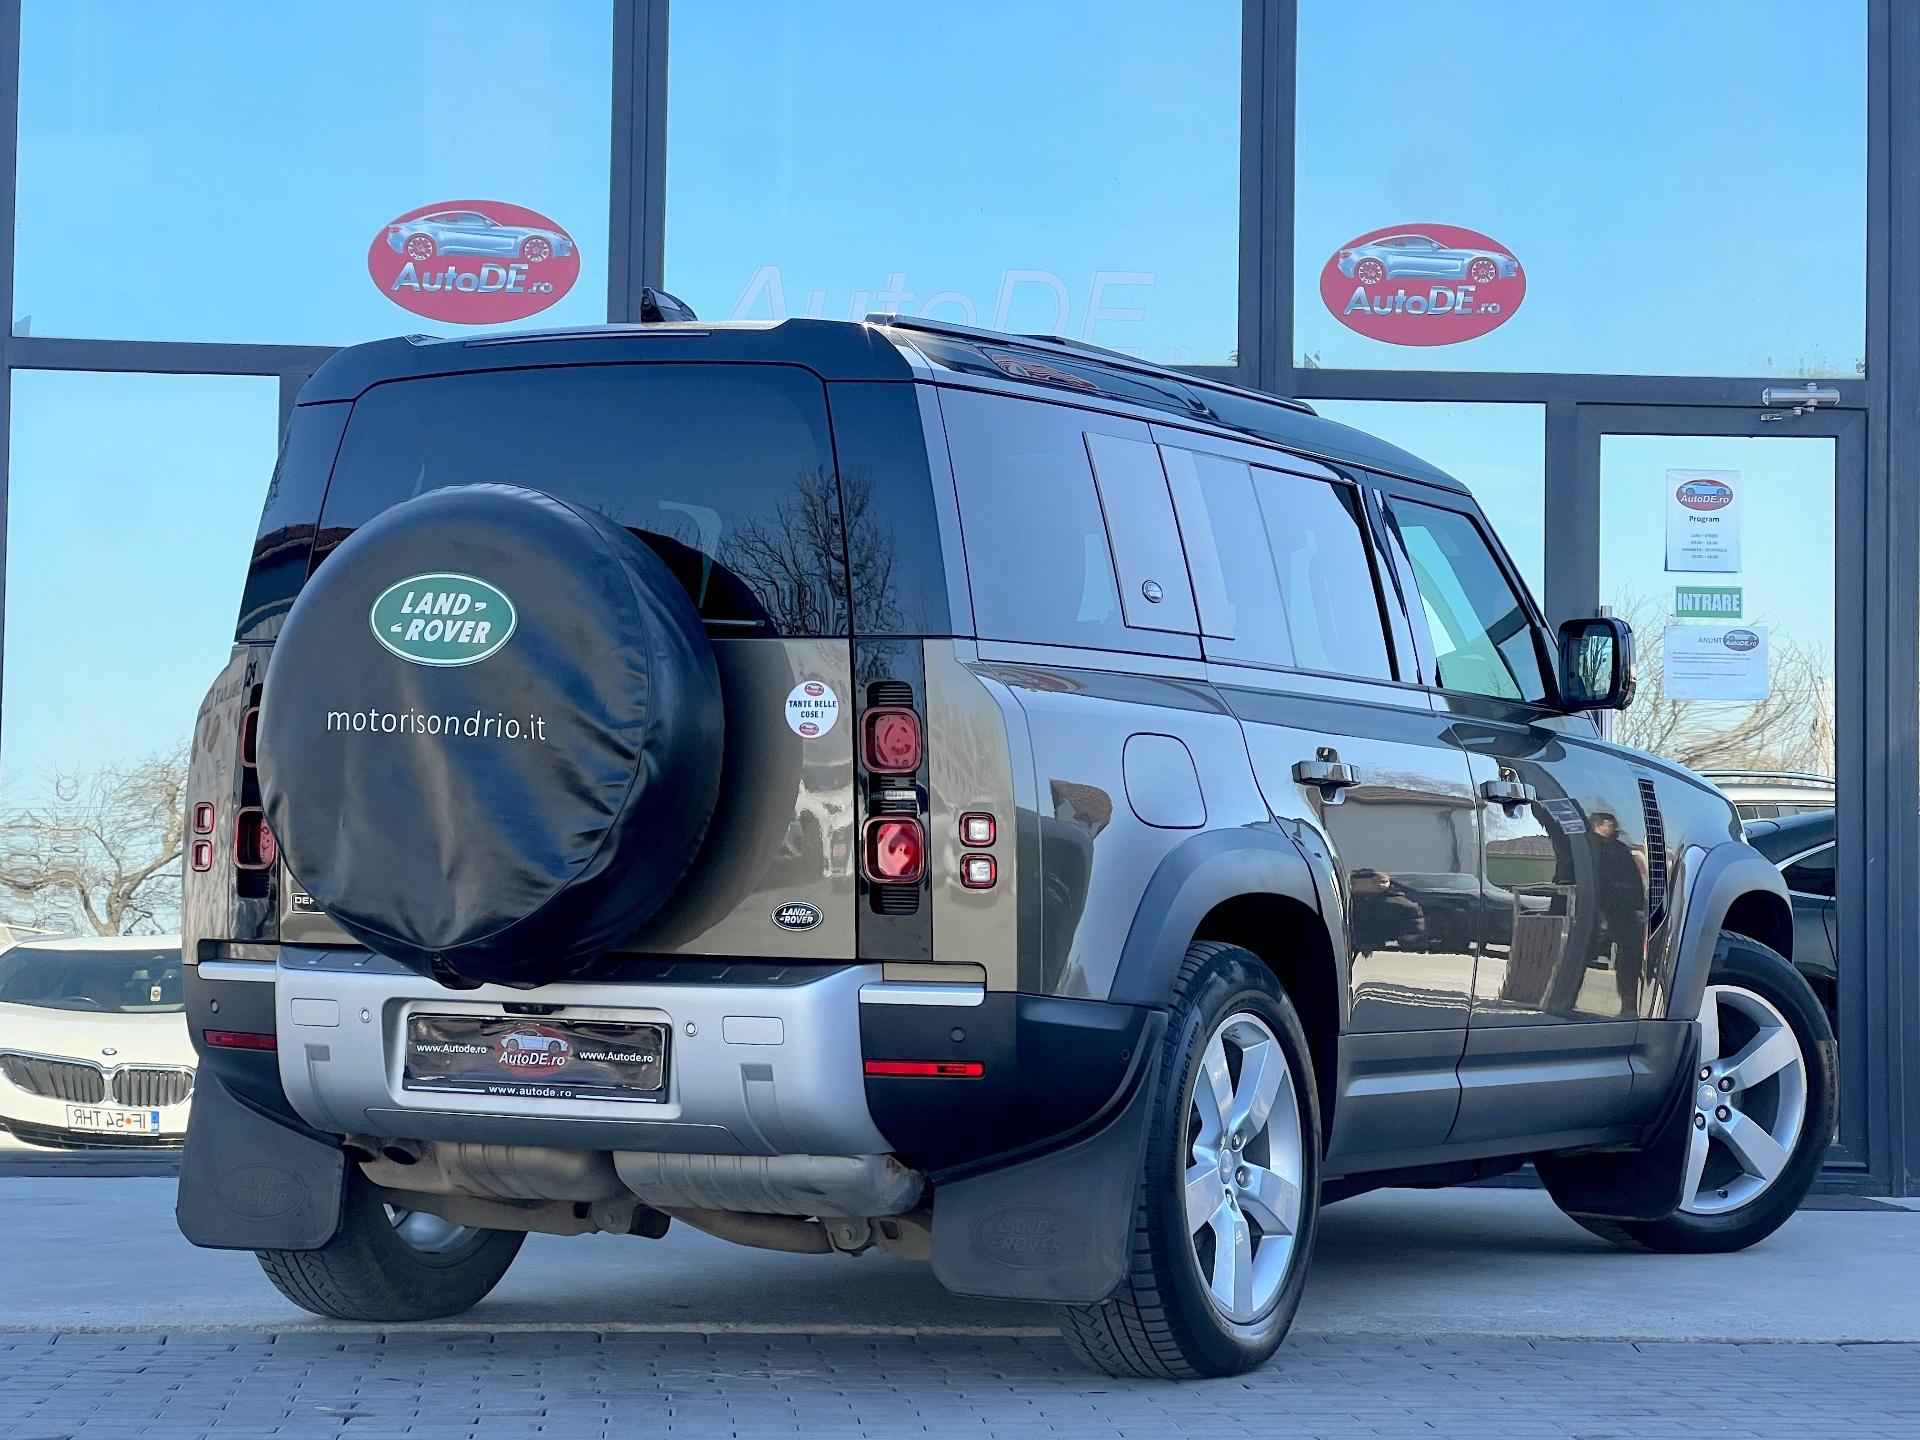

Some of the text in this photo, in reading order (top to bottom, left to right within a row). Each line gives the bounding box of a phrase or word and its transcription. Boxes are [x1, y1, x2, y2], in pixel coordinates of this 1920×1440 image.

[390, 261, 555, 294] AutoDE.ro
[1343, 284, 1501, 317] AutoDE.ro
[1689, 515, 1720, 524] Program
[400, 591, 472, 616] LAND
[1677, 592, 1741, 612] INTRARE
[404, 618, 491, 644] ROVER
[788, 700, 837, 708] TANTE BELLE
[327, 708, 546, 741] motorisondrio.it
[781, 908, 806, 916] LAND
[784, 915, 813, 924] ROVER
[416, 1043, 487, 1054] www.Autode.ro
[498, 1051, 565, 1066] AutoDE.ro
[579, 1051, 653, 1063] www.Autode.ro
[488, 1086, 572, 1097] www.autode.ro
